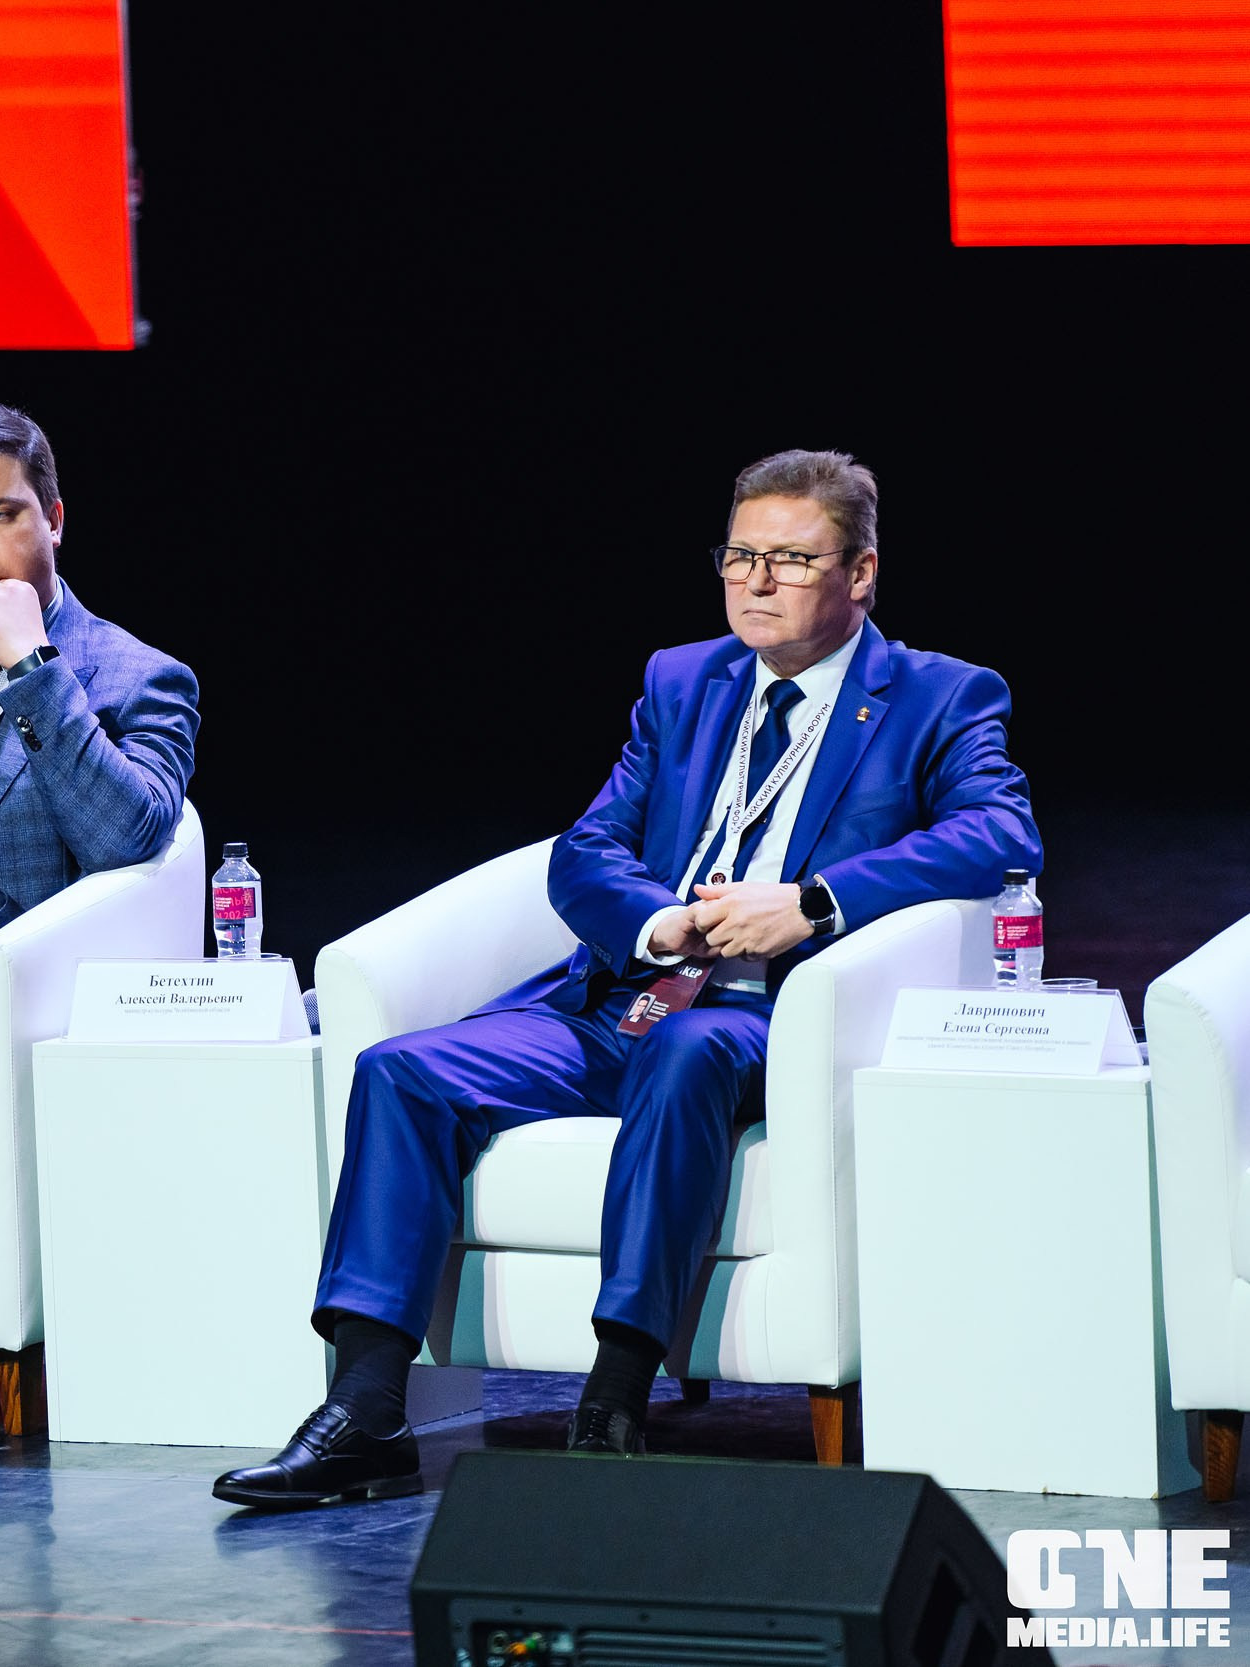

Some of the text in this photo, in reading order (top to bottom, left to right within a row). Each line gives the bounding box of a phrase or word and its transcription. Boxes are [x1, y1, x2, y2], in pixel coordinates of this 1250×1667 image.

[773, 733, 810, 786] КУЛЬТУРНЫЙ
[807, 703, 830, 733] ФОРУМ
[149, 975, 214, 987] Бетехтин
[115, 992, 243, 1006] Алексей Валерьевич
[954, 1003, 1046, 1018] Лавринович
[943, 1021, 1050, 1036] Елена Сергеевна
